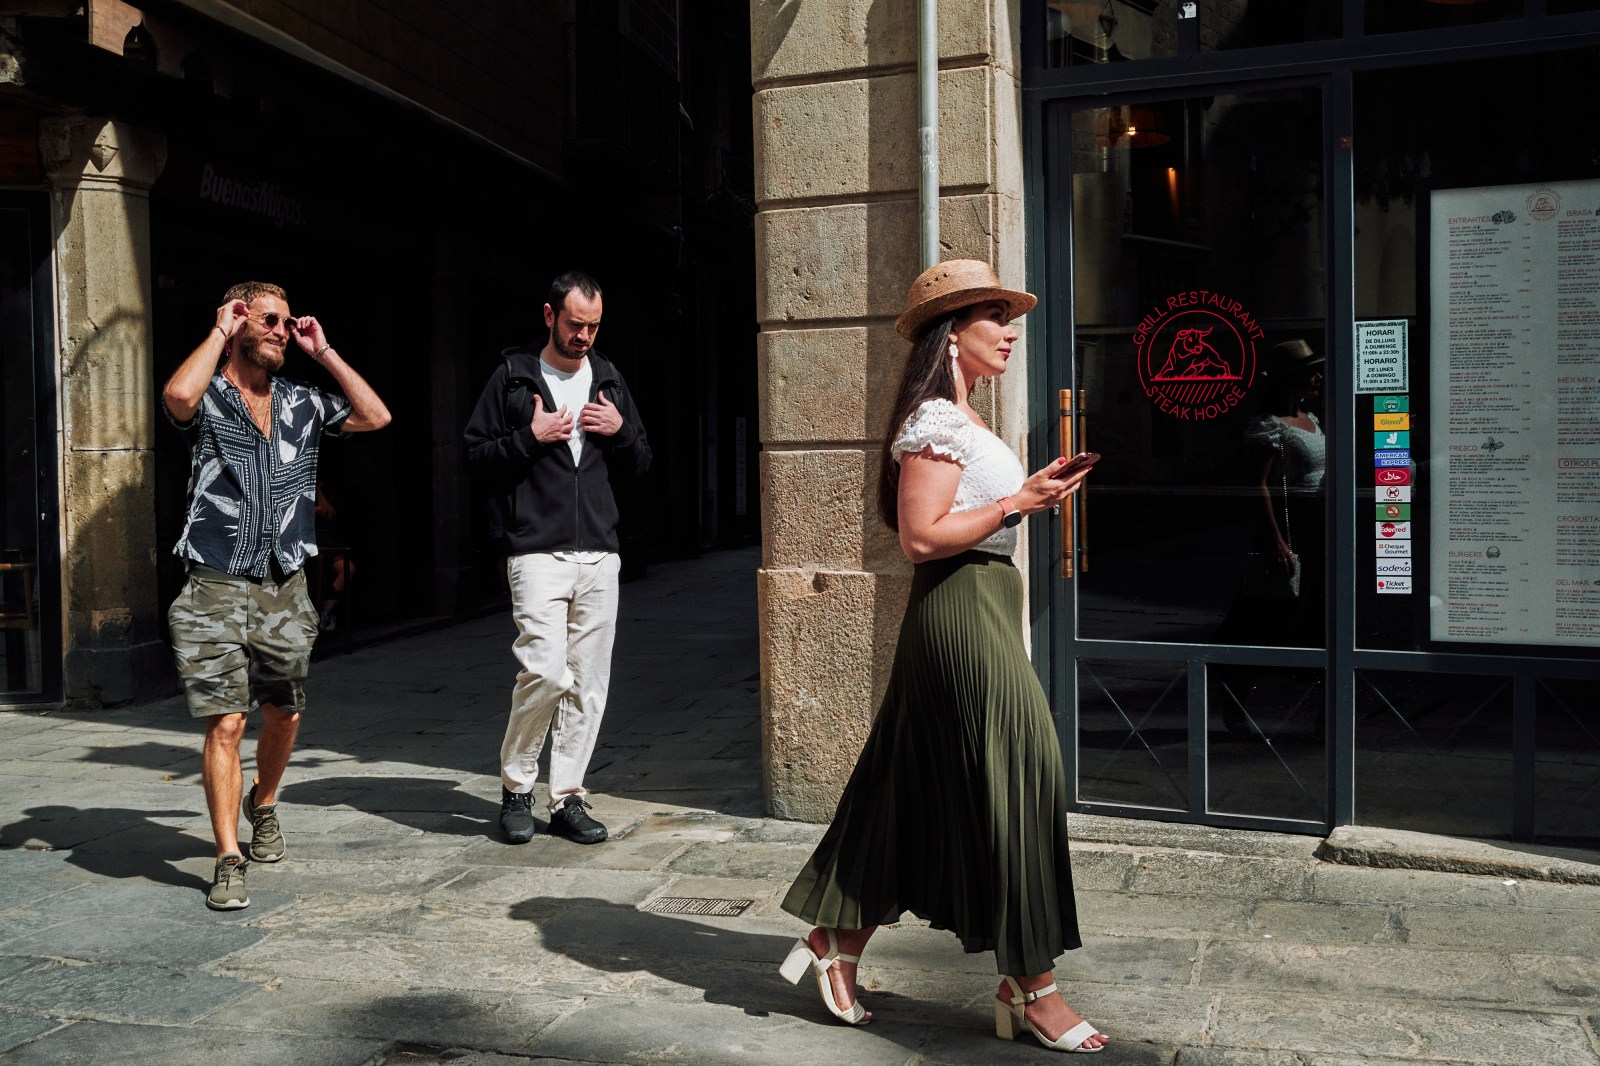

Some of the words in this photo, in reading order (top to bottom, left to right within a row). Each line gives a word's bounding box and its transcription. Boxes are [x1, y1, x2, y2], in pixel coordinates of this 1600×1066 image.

[1448, 216, 1490, 224] ENTRANTES
[1133, 307, 1168, 344] GRILL
[1167, 290, 1264, 338] RESTAURANT
[1146, 386, 1190, 420] STEAK
[1194, 384, 1246, 420] HOUSE
